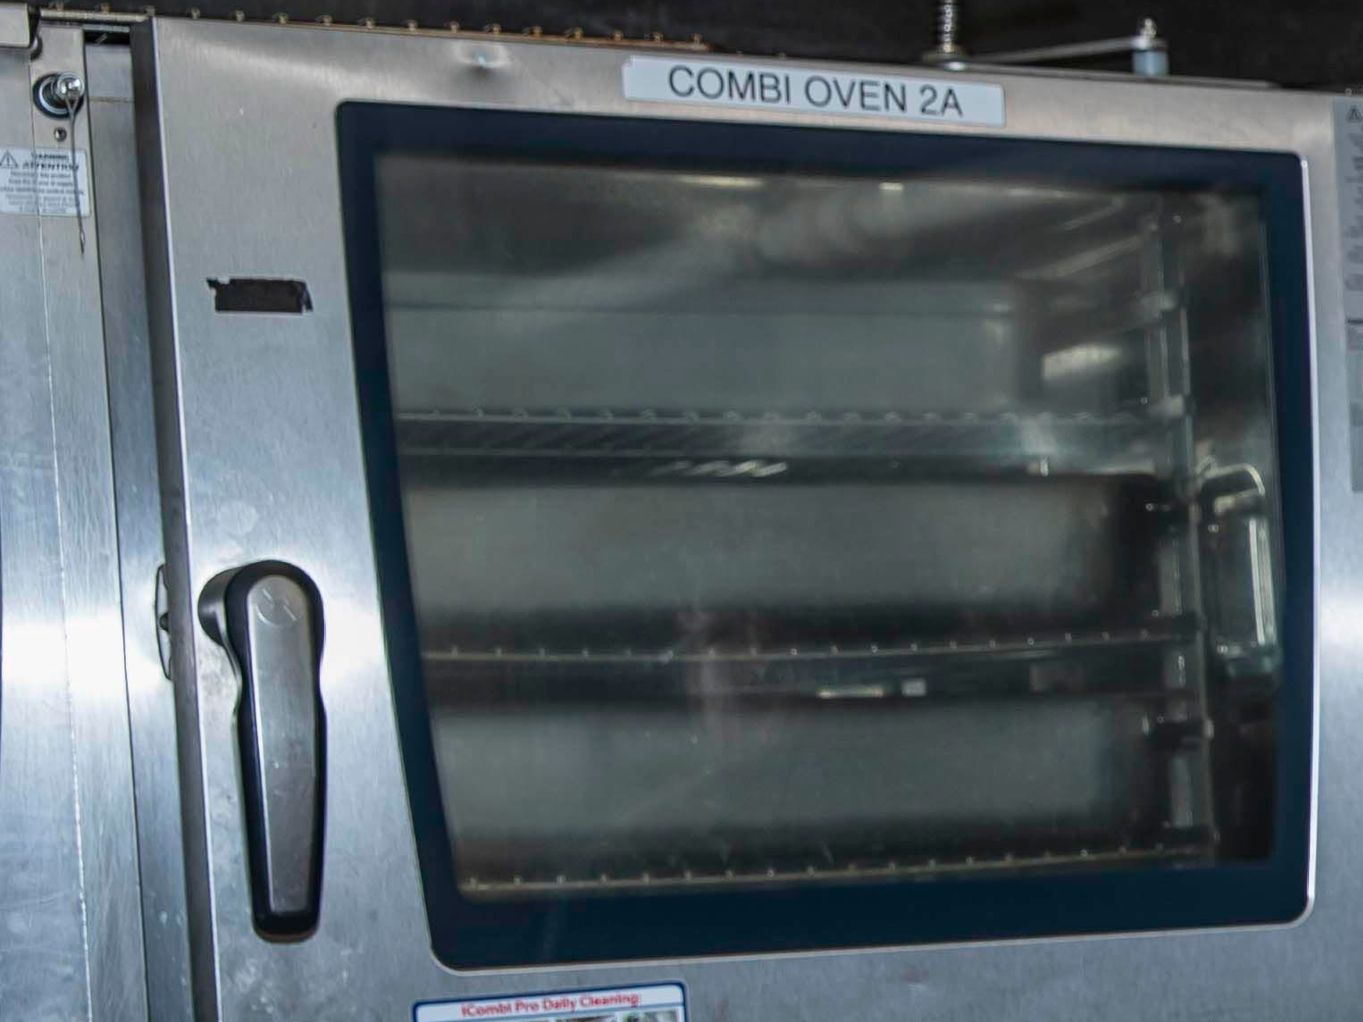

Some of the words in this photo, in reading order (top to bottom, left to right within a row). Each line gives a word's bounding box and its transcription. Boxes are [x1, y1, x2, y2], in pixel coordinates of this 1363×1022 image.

[668, 64, 791, 104] COMBI
[804, 76, 908, 113] OVEN
[919, 85, 963, 117] 2A
[515, 999, 540, 1013] Pro
[543, 997, 577, 1014] Daily
